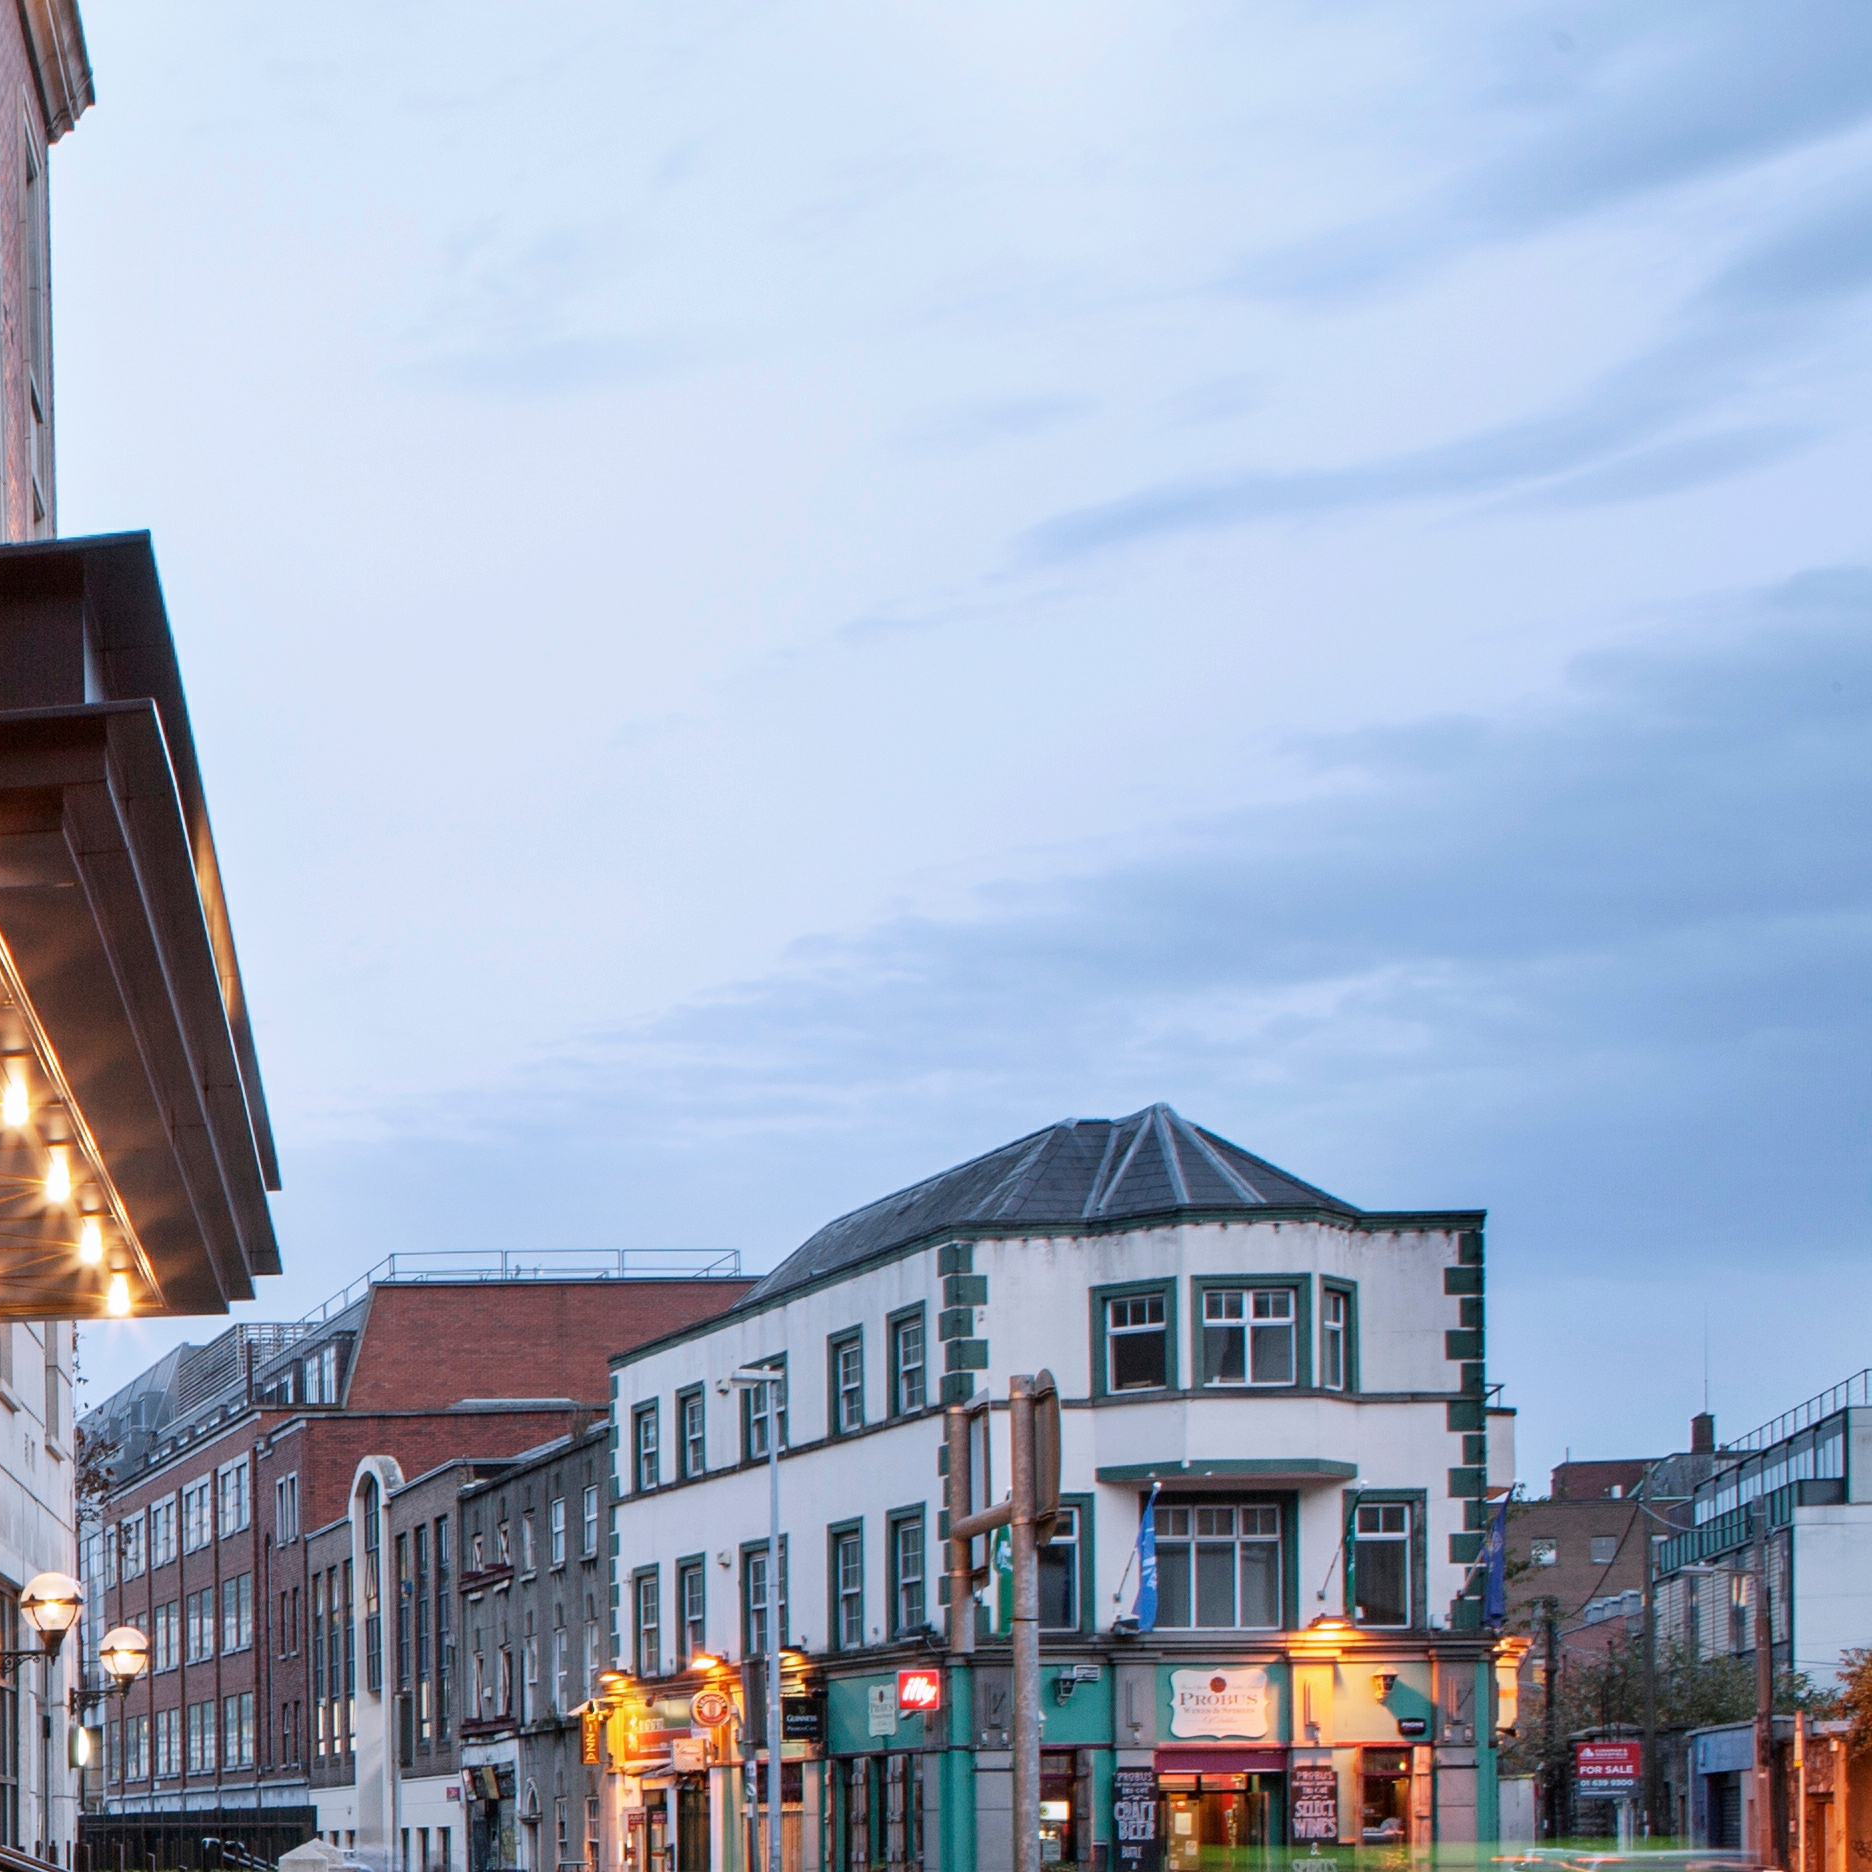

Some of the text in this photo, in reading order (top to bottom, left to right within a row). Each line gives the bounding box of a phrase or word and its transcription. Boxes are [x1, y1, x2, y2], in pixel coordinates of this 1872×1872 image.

[901, 1676, 938, 1707] illy
[1179, 1692, 1259, 1706] PROBUS
[585, 1714, 597, 1761] PIZZA
[1579, 1764, 1634, 1774] FOR SALE
[1114, 1801, 1156, 1820] CRAFT
[1294, 1799, 1336, 1818] SELECT
[1118, 1821, 1155, 1840] BEER
[1292, 1818, 1337, 1838] WINES
[1310, 1842, 1321, 1856] &
